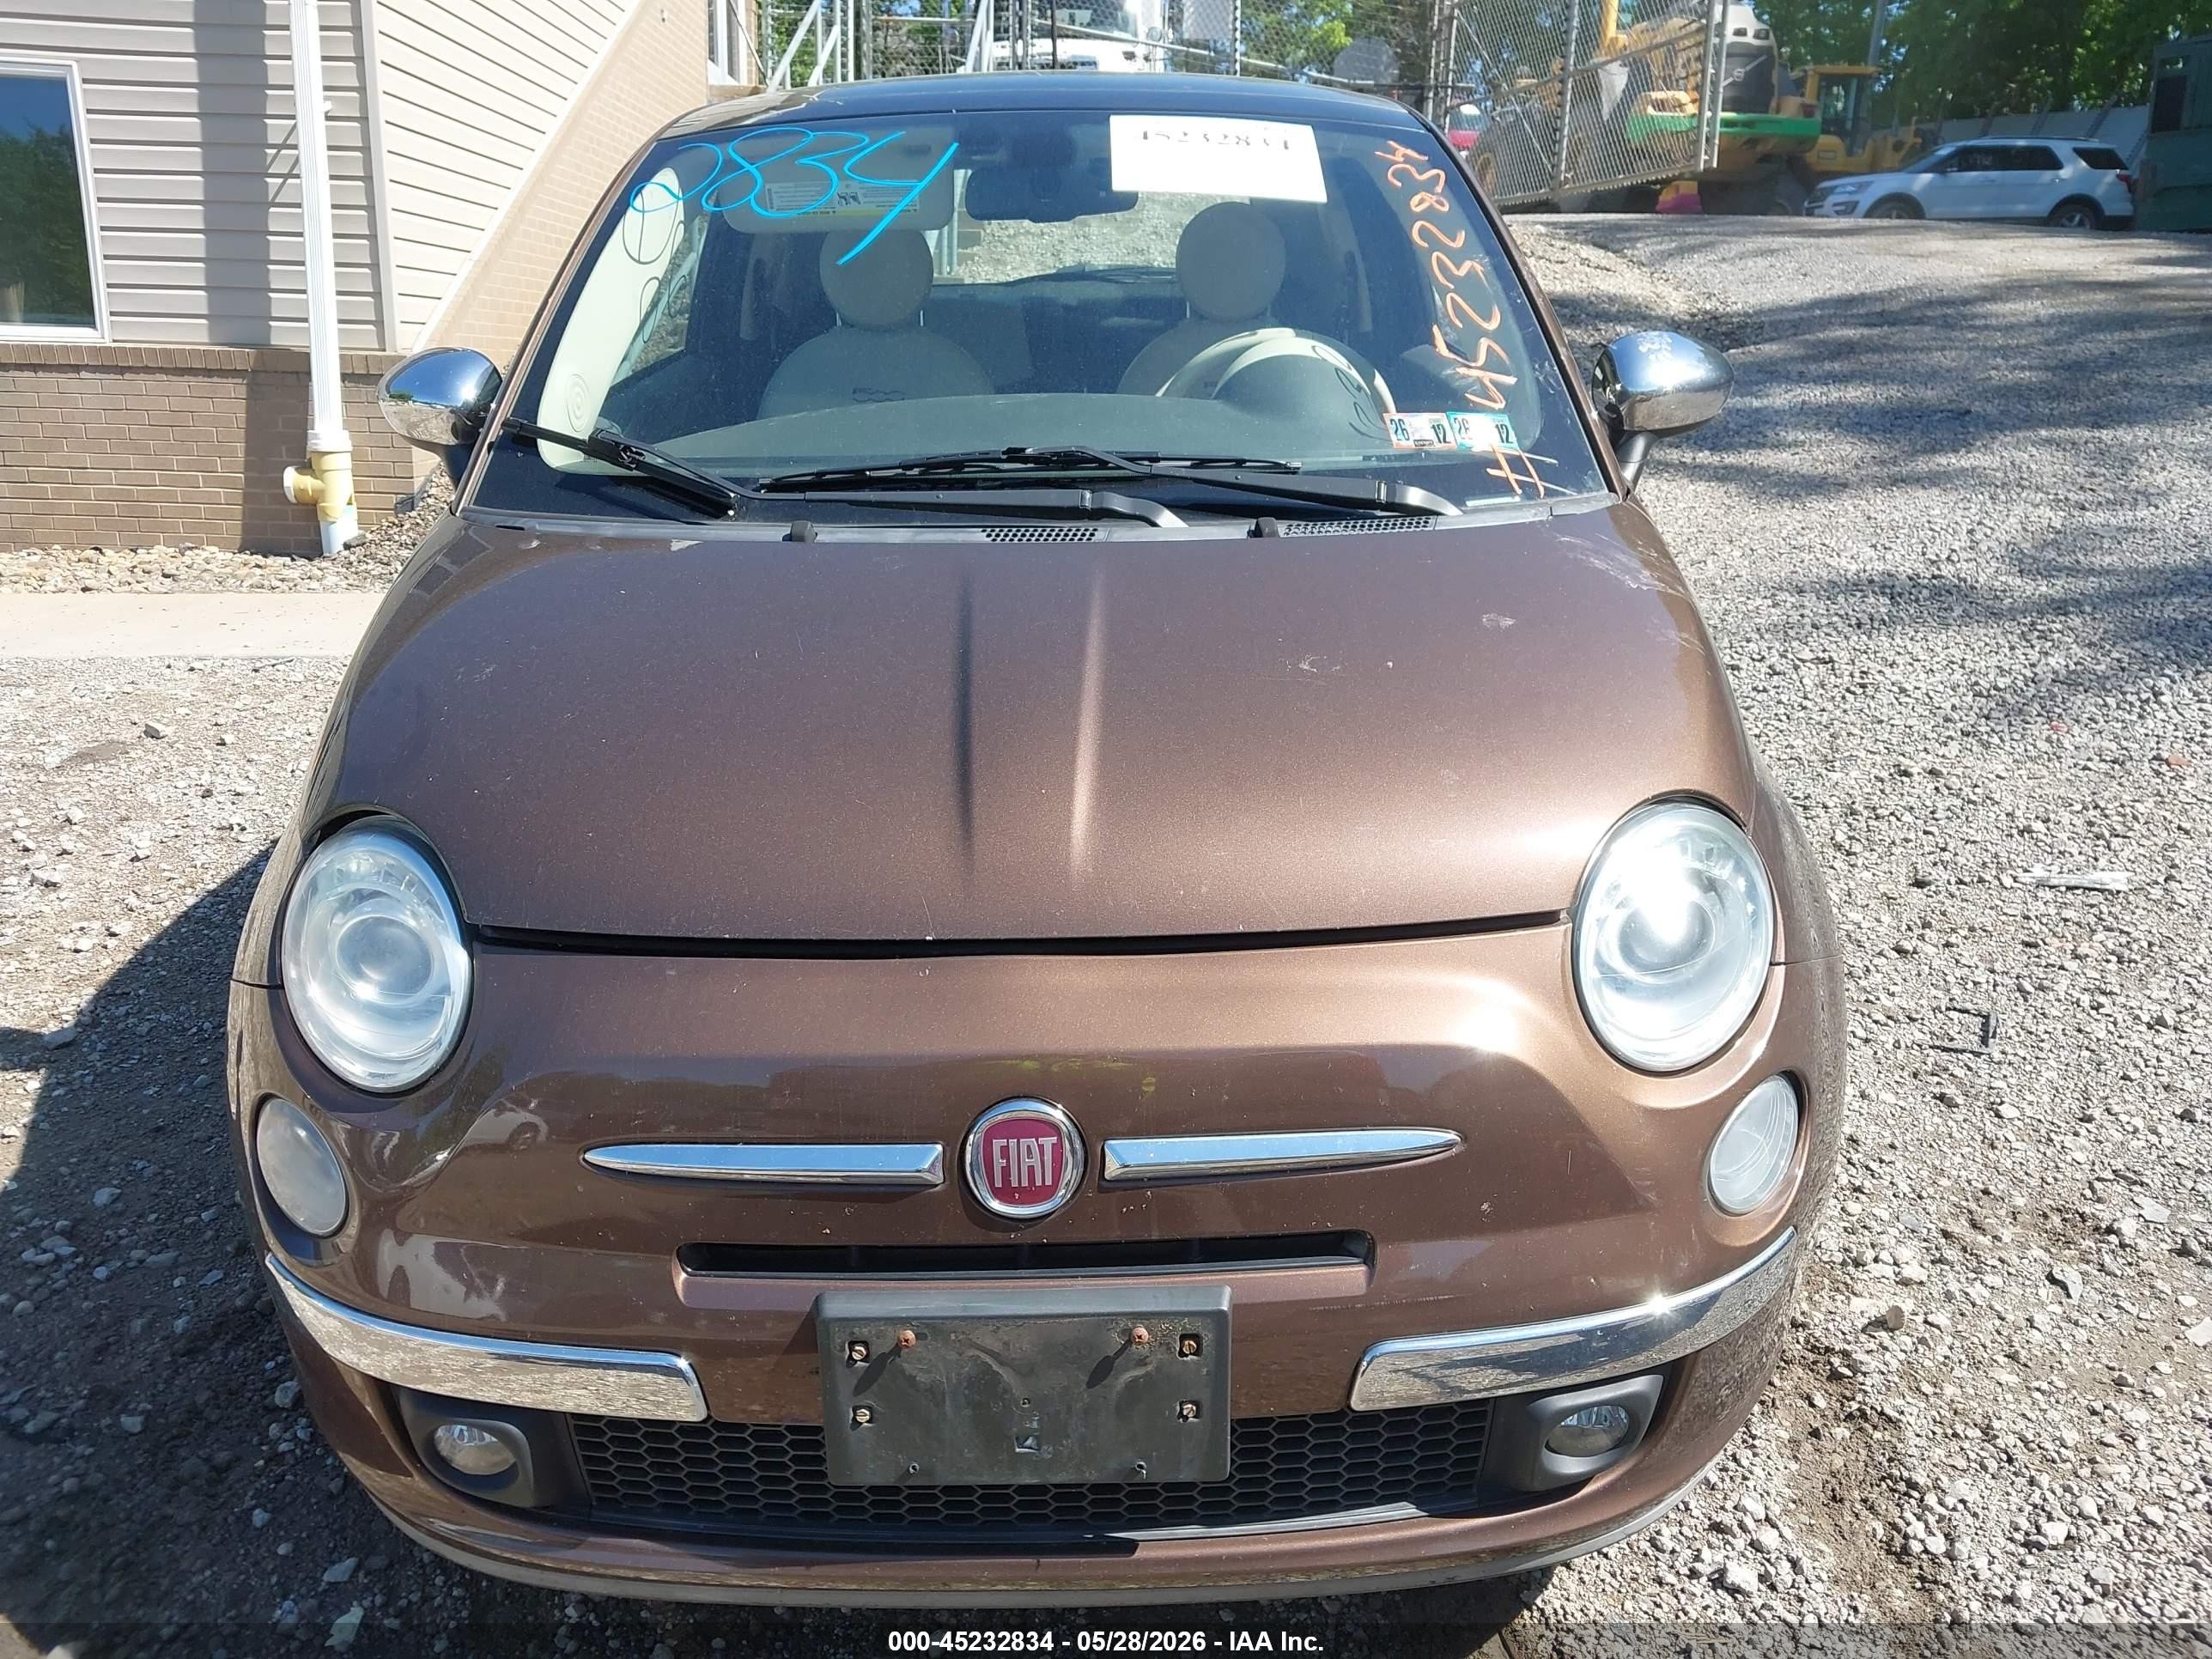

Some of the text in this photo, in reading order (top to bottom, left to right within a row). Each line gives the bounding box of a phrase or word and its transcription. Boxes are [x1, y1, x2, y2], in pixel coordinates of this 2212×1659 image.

[629, 127, 959, 264] 2834
[1390, 418, 1451, 445] 26 12
[1494, 423, 1514, 444] 12
[993, 1137, 1058, 1188] FIAT
